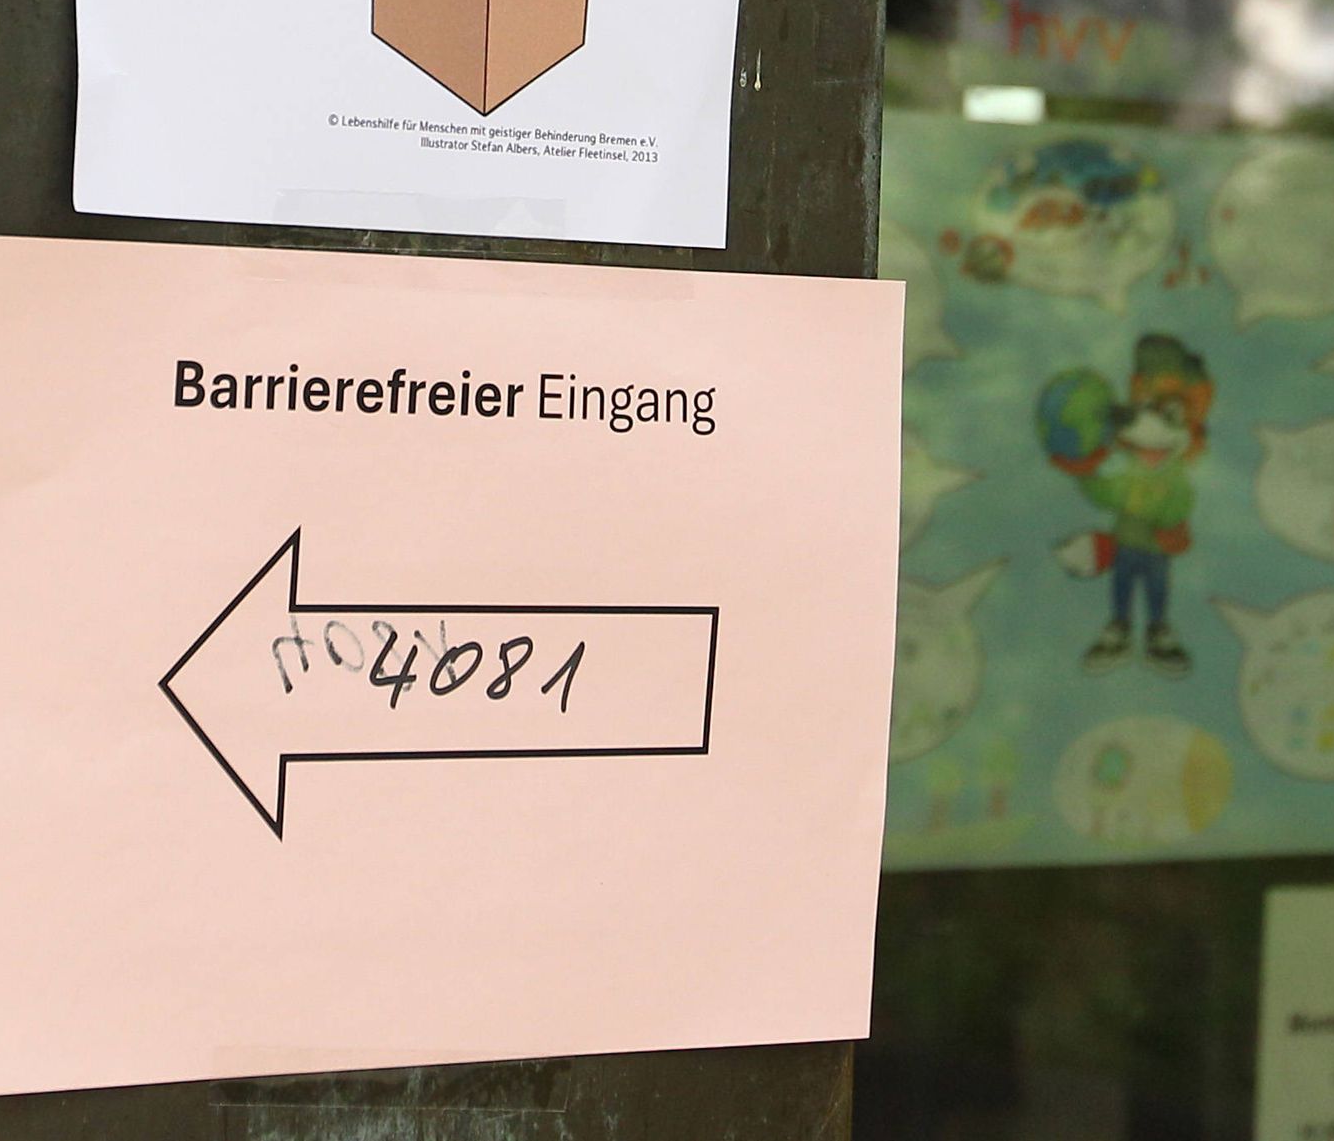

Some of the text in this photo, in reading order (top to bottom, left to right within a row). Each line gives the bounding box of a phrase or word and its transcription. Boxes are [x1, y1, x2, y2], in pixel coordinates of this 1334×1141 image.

[341, 115, 400, 131] Lebenshilfe
[402, 118, 417, 131] für
[419, 120, 468, 135] Menschen
[470, 125, 486, 136] mit
[488, 127, 532, 141] geistiger
[534, 128, 597, 146] Behinderung
[599, 133, 638, 146] Bremen
[420, 136, 658, 163] Illustrator Stefan Albers, Atelier Fleetinsel, 2013
[174, 359, 718, 436] Barrierefreier Eingang
[369, 629, 585, 713] 4081
